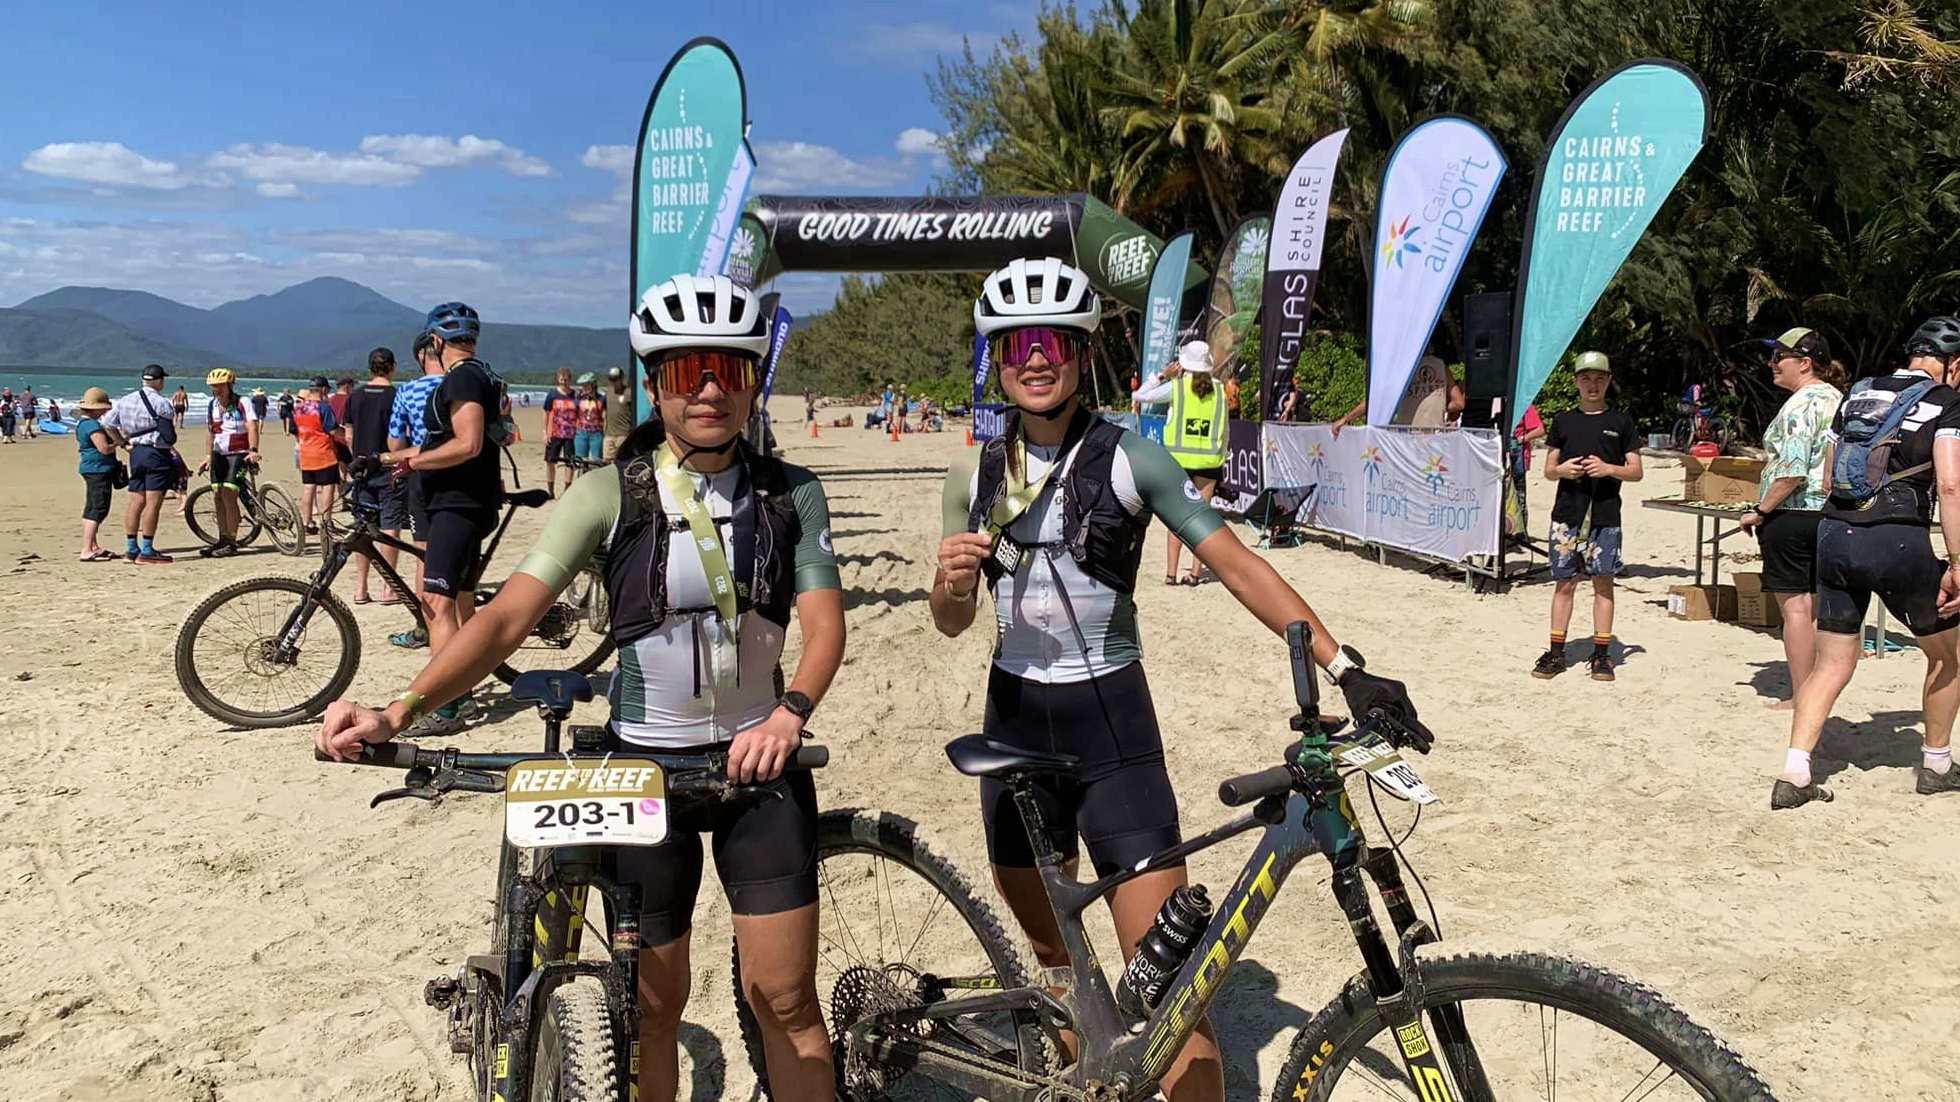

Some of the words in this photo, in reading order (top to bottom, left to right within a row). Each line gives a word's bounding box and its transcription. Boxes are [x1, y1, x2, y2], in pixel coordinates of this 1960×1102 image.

[651, 126, 703, 151] CAIRNS
[705, 132, 713, 148] &
[1565, 136, 1642, 158] CAIRNS
[1645, 143, 1656, 156] &
[652, 155, 694, 179] GREAT
[1562, 162, 1624, 183] GREAT
[653, 182, 709, 206] BARRIER
[1423, 161, 1461, 221] Cairns
[1560, 187, 1646, 207] BARRIER
[652, 211, 684, 234] REEF
[799, 213, 870, 240] GOOD
[872, 213, 943, 240] TIMES
[948, 211, 1053, 239] ROLLING
[1288, 176, 1312, 261] SHIRE
[1301, 177, 1322, 261] COUNCIL
[1424, 155, 1490, 273] airport
[1557, 212, 1604, 232] REEF
[1108, 235, 1146, 266] REEF
[1114, 251, 1150, 282] REEF
[1366, 491, 1410, 523] airport
[1428, 500, 1481, 538] airport
[510, 769, 580, 792] REEF
[589, 767, 655, 790] REEF
[534, 801, 635, 829] 203-1
[1162, 924, 1189, 944] SWISS
